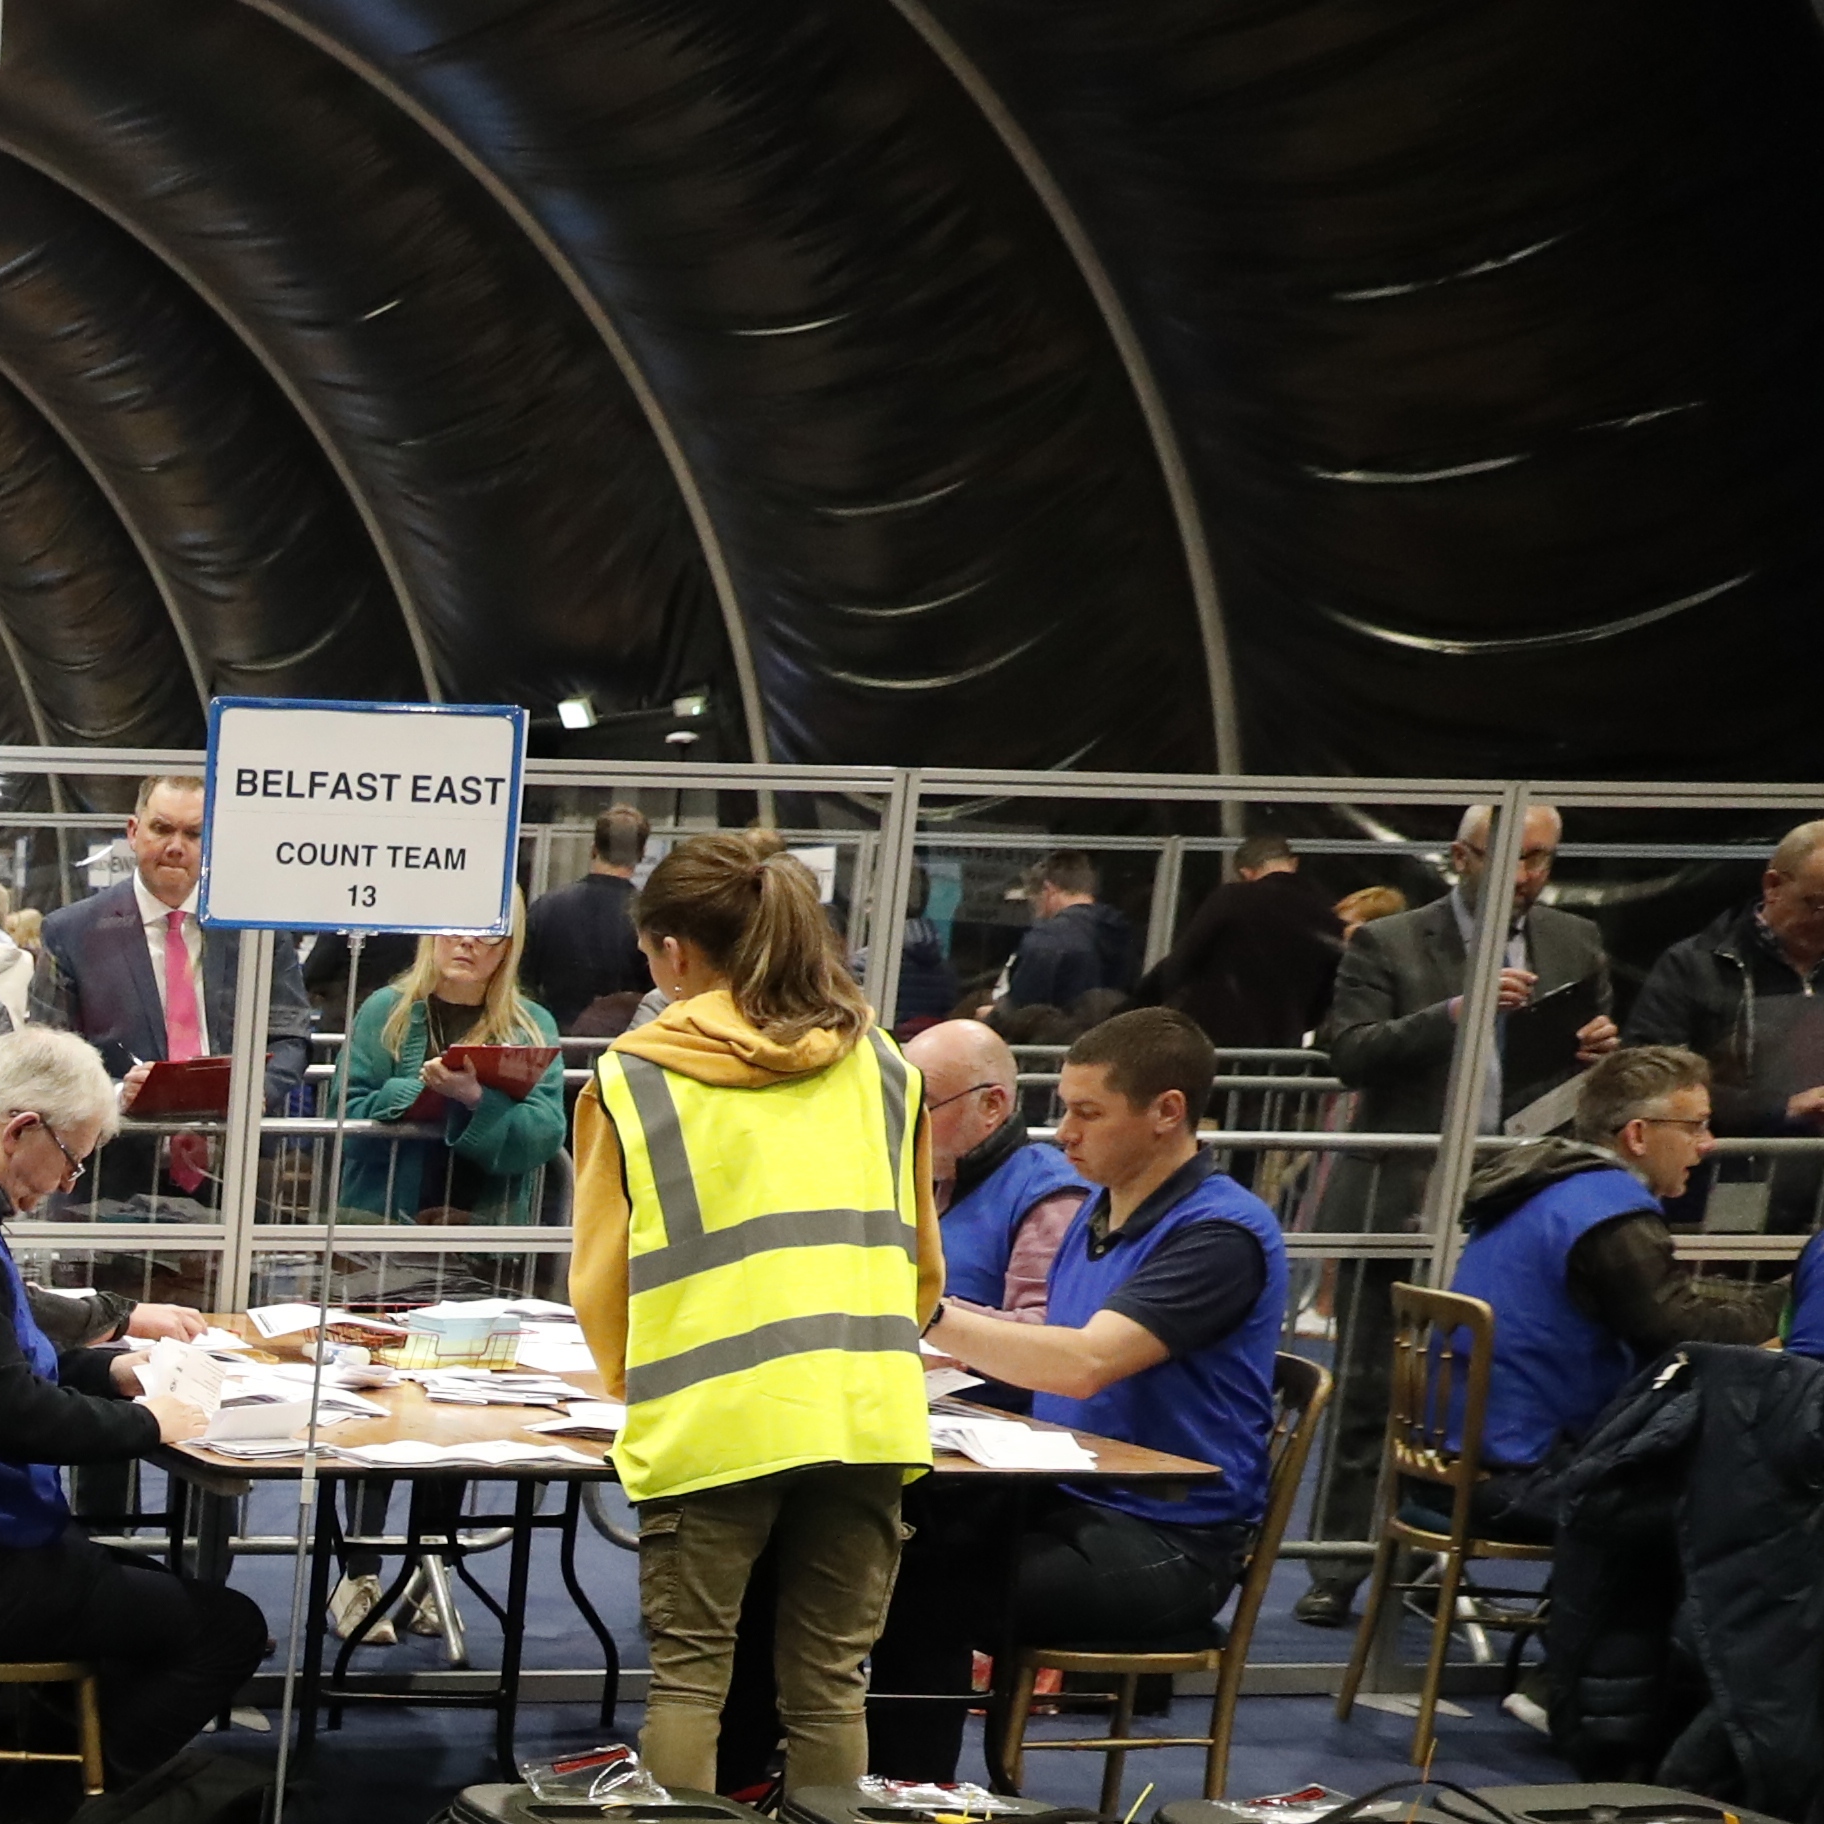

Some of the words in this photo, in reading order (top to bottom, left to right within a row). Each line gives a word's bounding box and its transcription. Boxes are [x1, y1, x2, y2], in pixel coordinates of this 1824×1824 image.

[235, 768, 401, 802] BELFAST
[410, 775, 506, 805] EAST
[276, 842, 378, 868] COUNT
[387, 845, 466, 871] TEAM
[347, 884, 377, 908] 13
